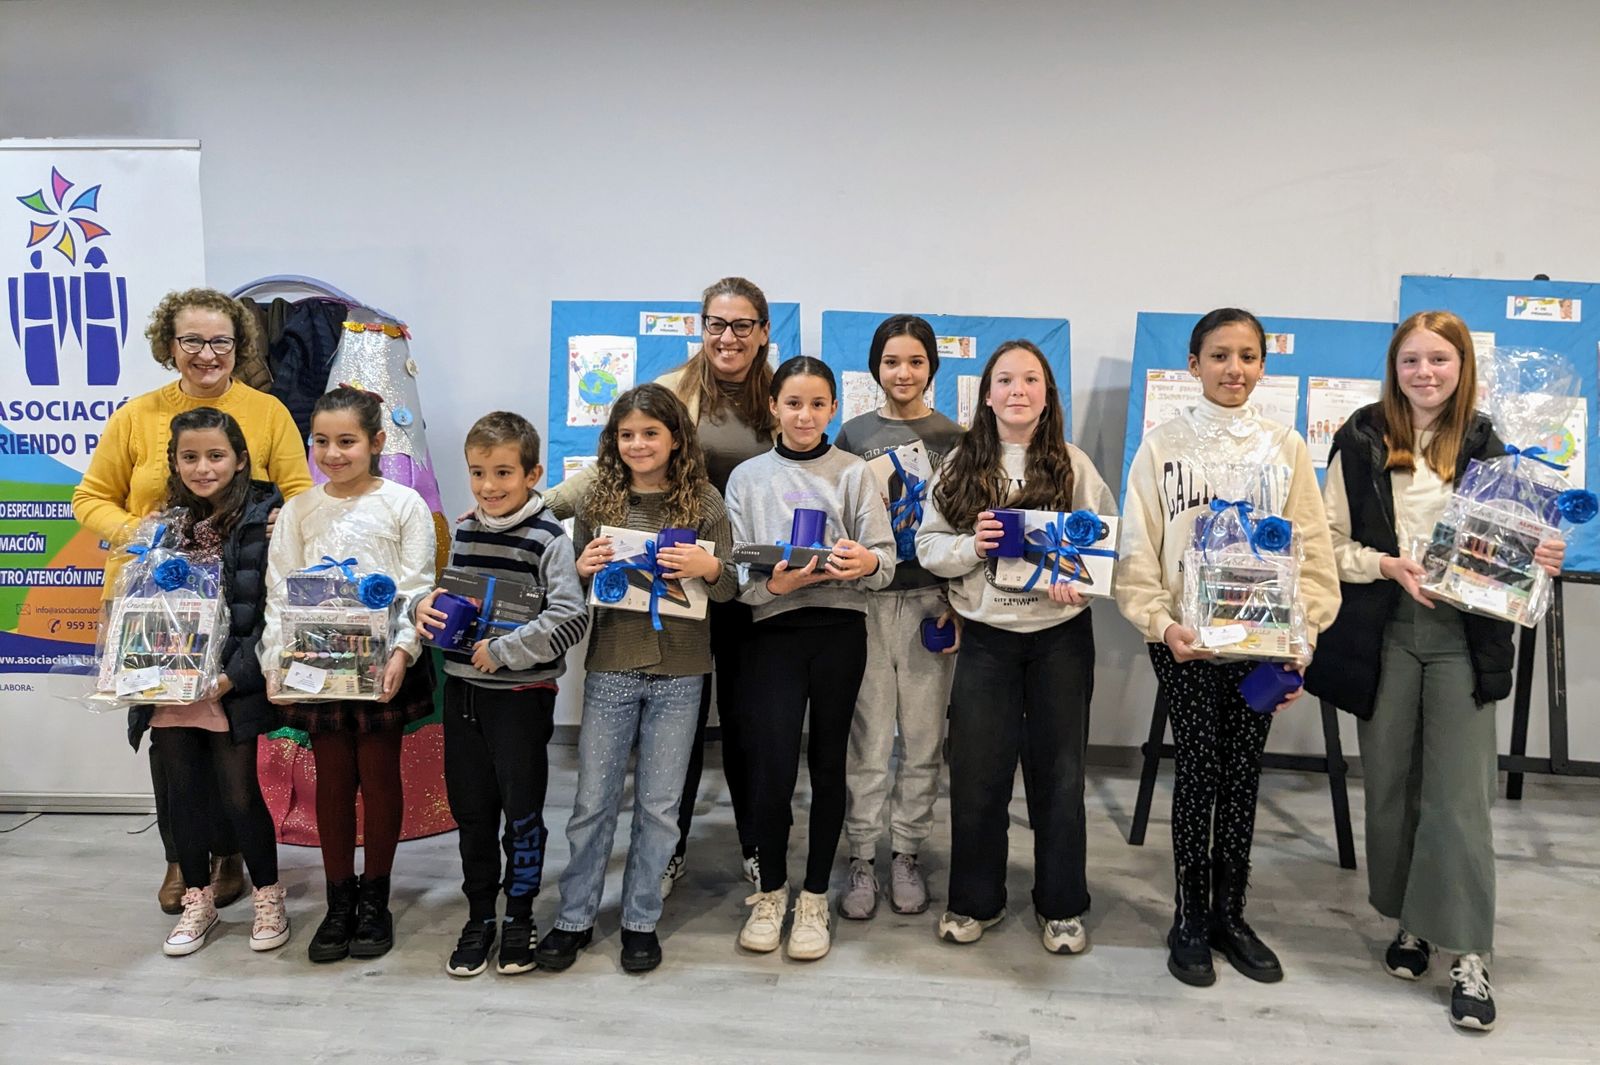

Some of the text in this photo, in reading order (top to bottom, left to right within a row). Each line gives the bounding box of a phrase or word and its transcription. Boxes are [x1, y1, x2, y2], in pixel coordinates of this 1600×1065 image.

[85, 433, 103, 455] P
[8, 503, 44, 518] ESPECIAL
[46, 503, 57, 518] DE
[0, 534, 44, 552] MACIÓN
[0, 570, 24, 585] TRO
[26, 567, 82, 585] ATENCIÓN
[66, 620, 85, 630] 959
